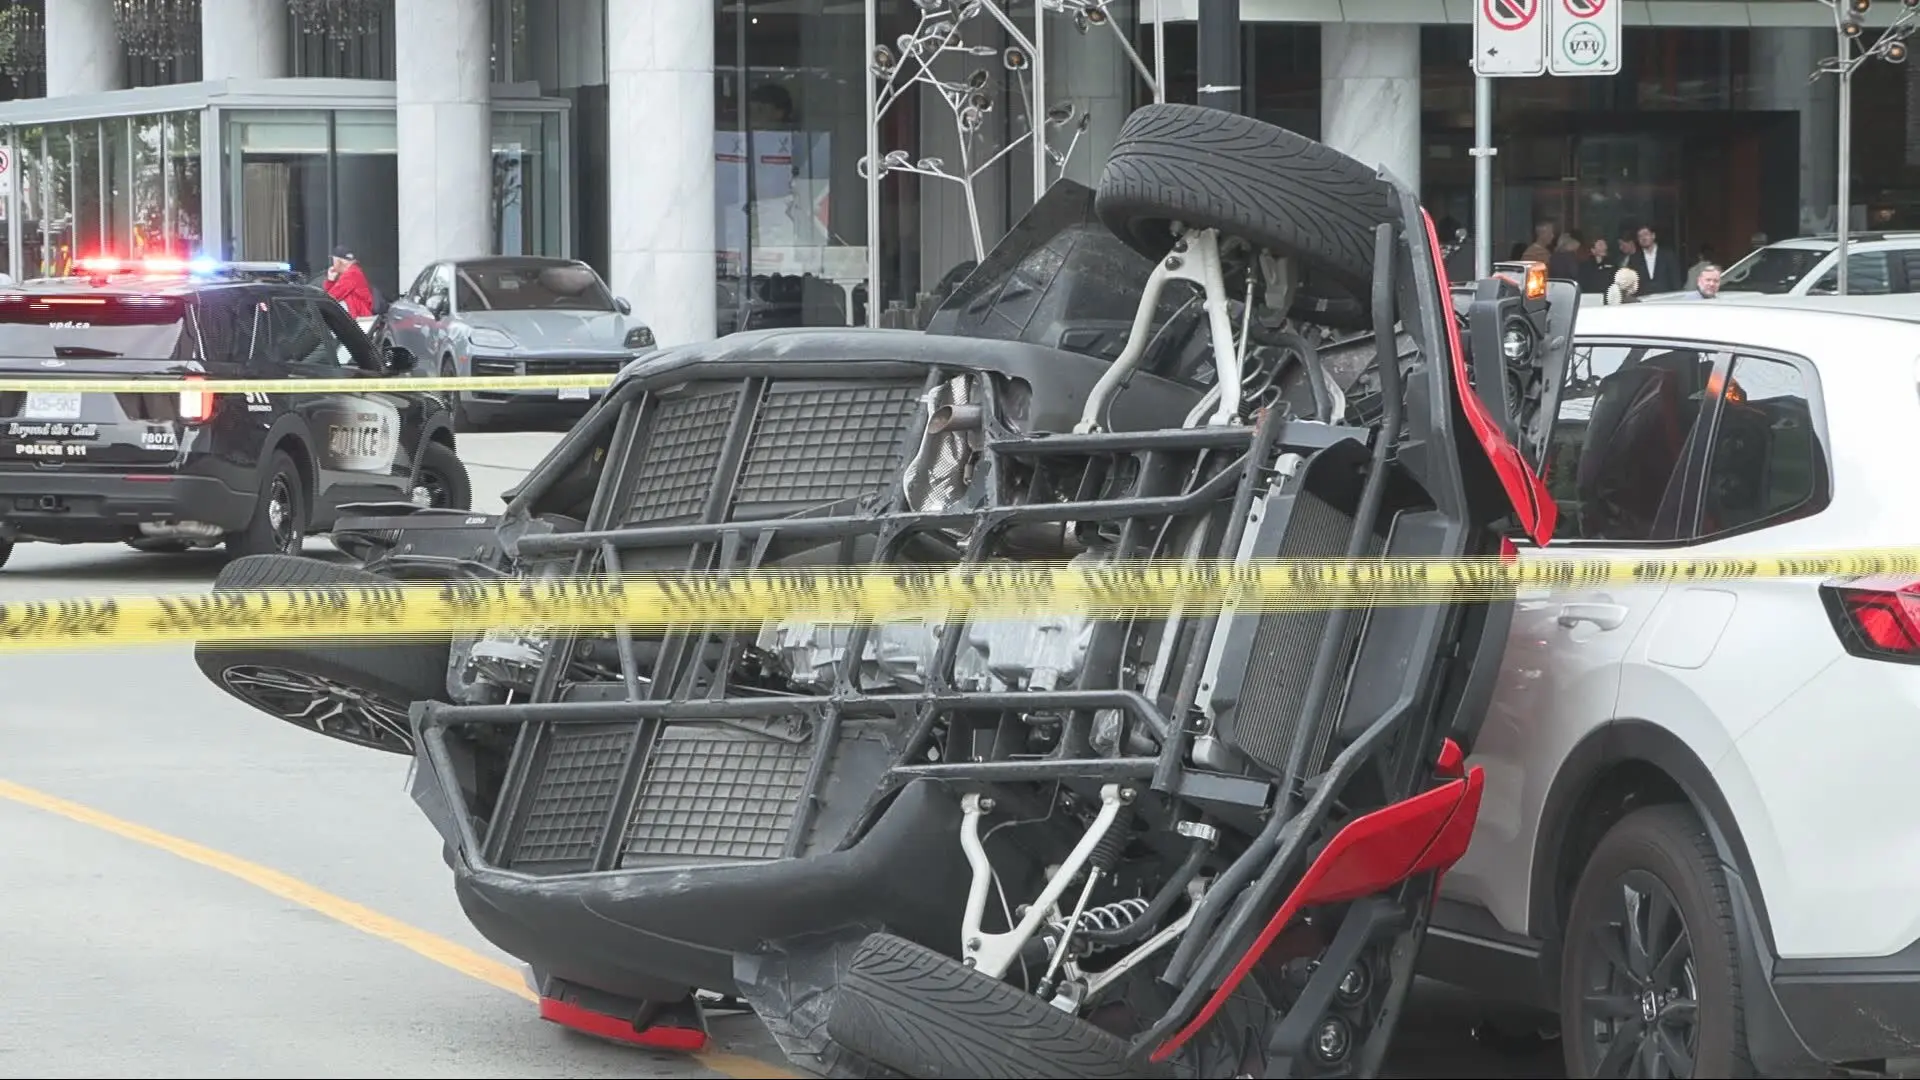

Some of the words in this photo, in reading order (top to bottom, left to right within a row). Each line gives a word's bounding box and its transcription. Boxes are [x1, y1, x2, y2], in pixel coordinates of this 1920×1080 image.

[1571, 41, 1599, 51] TAXI
[49, 321, 90, 330] vpd.ca
[8, 422, 51, 438] Beyond
[51, 423, 69, 435] the
[71, 423, 97, 436] Call
[141, 433, 175, 443] F8077
[330, 426, 379, 457] POLICE
[16, 444, 63, 455] POLICE
[67, 445, 86, 455] 911
